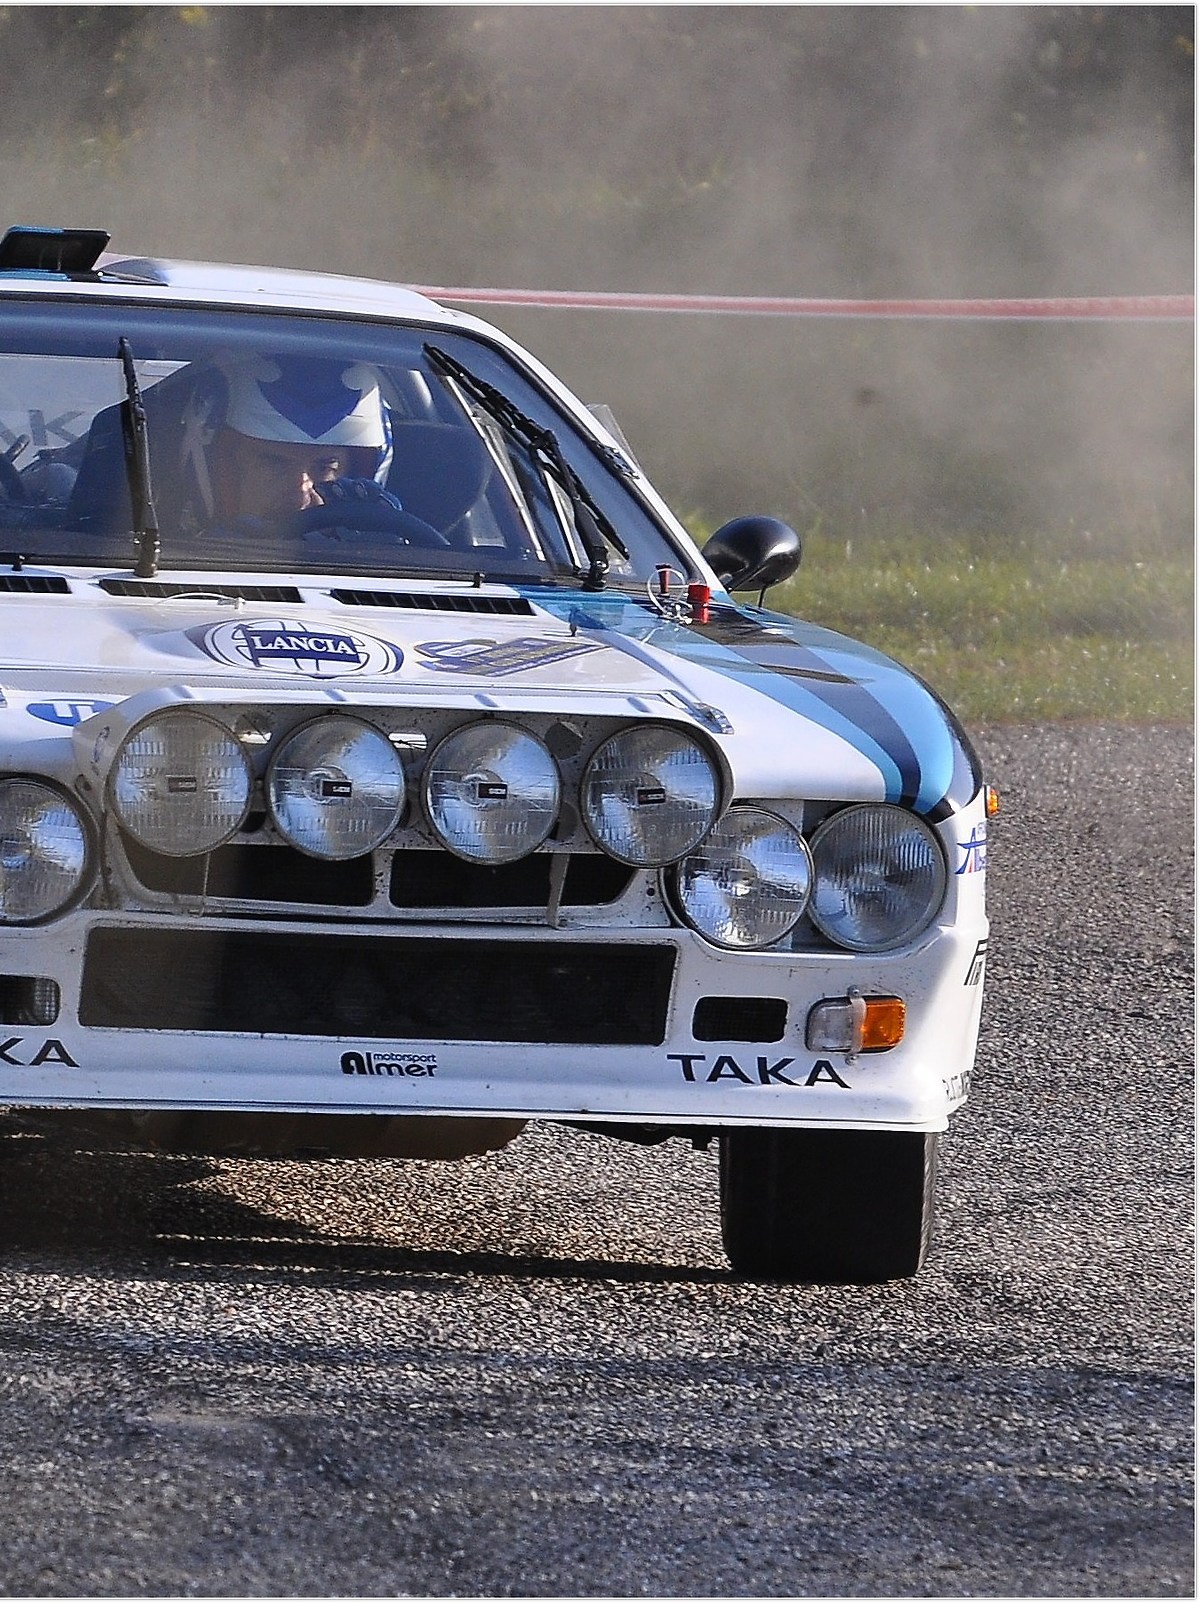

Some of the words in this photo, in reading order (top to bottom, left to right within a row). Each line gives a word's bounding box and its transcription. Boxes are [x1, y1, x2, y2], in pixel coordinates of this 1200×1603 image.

[251, 635, 358, 655] LANCIA
[340, 1051, 438, 1077] Almer
[373, 1053, 437, 1063] motorsport
[667, 1054, 851, 1089] TAKA
